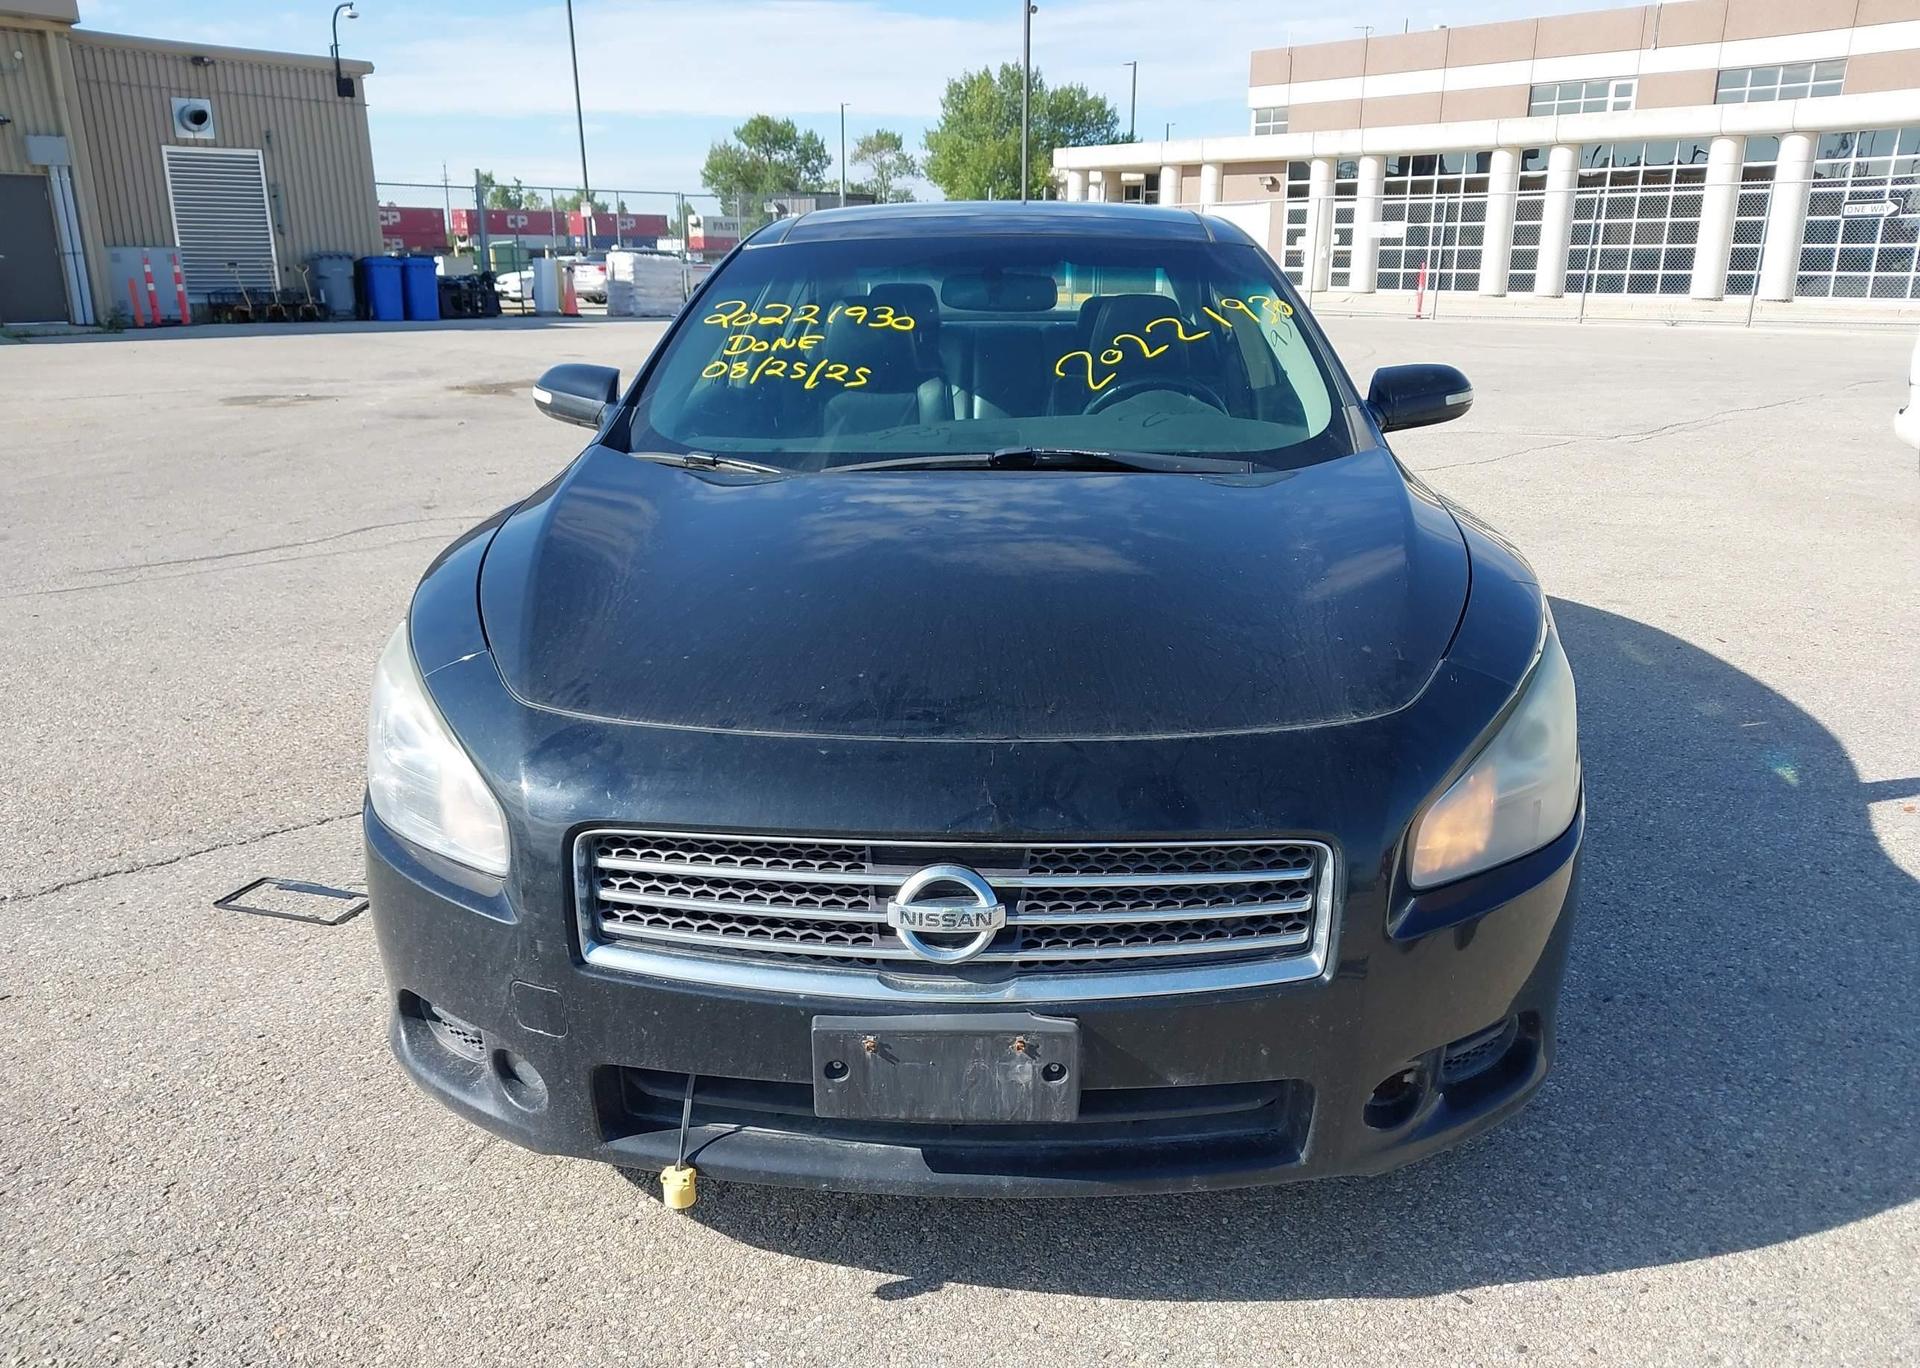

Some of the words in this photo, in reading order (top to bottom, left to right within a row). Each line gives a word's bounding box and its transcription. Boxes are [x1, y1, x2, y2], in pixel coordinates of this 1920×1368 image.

[1847, 205, 1868, 214] ONE
[1870, 204, 1891, 213] WAY
[378, 210, 401, 225] CP
[507, 214, 528, 228] CP
[619, 217, 636, 230] CP
[704, 300, 916, 330] 20221930
[1055, 295, 1293, 390] 20221930
[702, 356, 873, 389] 08/25/25
[899, 910, 992, 928] NISSAN
